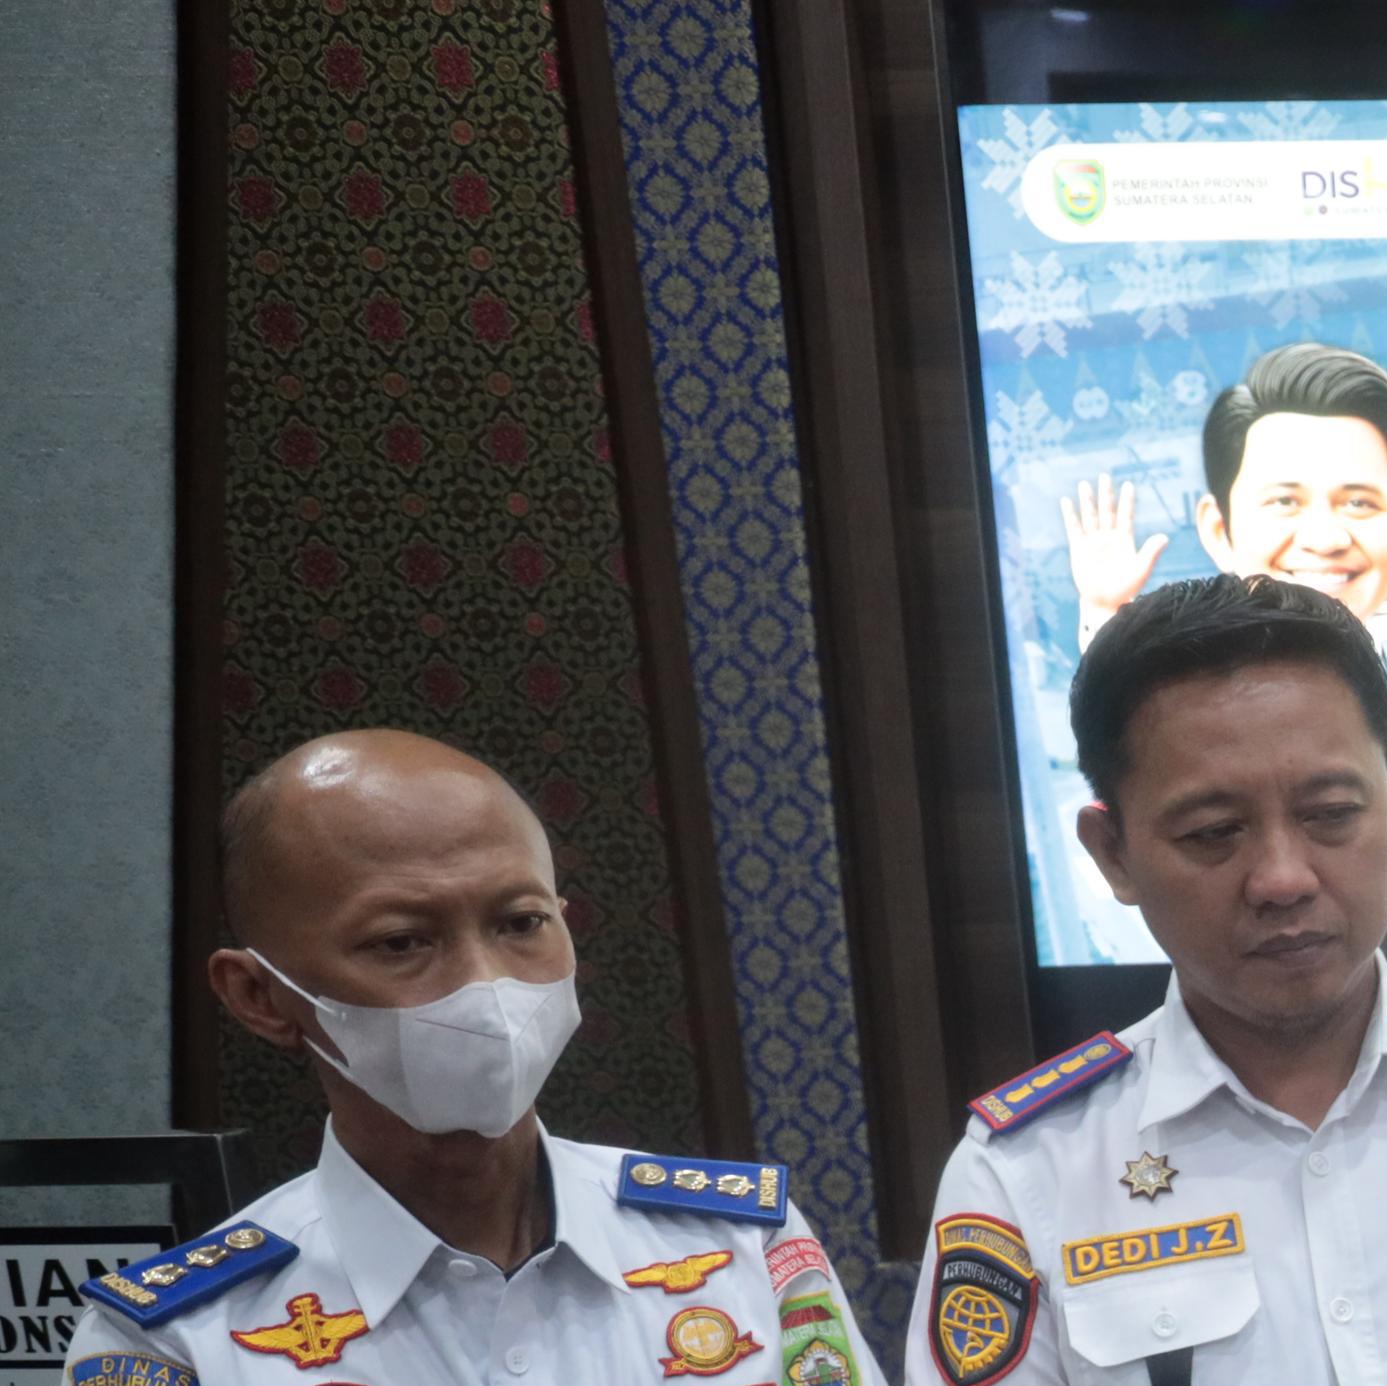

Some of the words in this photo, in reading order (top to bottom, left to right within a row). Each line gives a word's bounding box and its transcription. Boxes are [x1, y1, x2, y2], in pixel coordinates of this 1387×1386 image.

[1112, 178, 1200, 191] PEMERINTAH
[1203, 176, 1270, 189] PROVINSI
[1113, 194, 1190, 207] SUMATERA
[1193, 193, 1254, 206] SELATAN
[757, 1166, 780, 1210] DISHUB
[1076, 1233, 1160, 1275] DEDI
